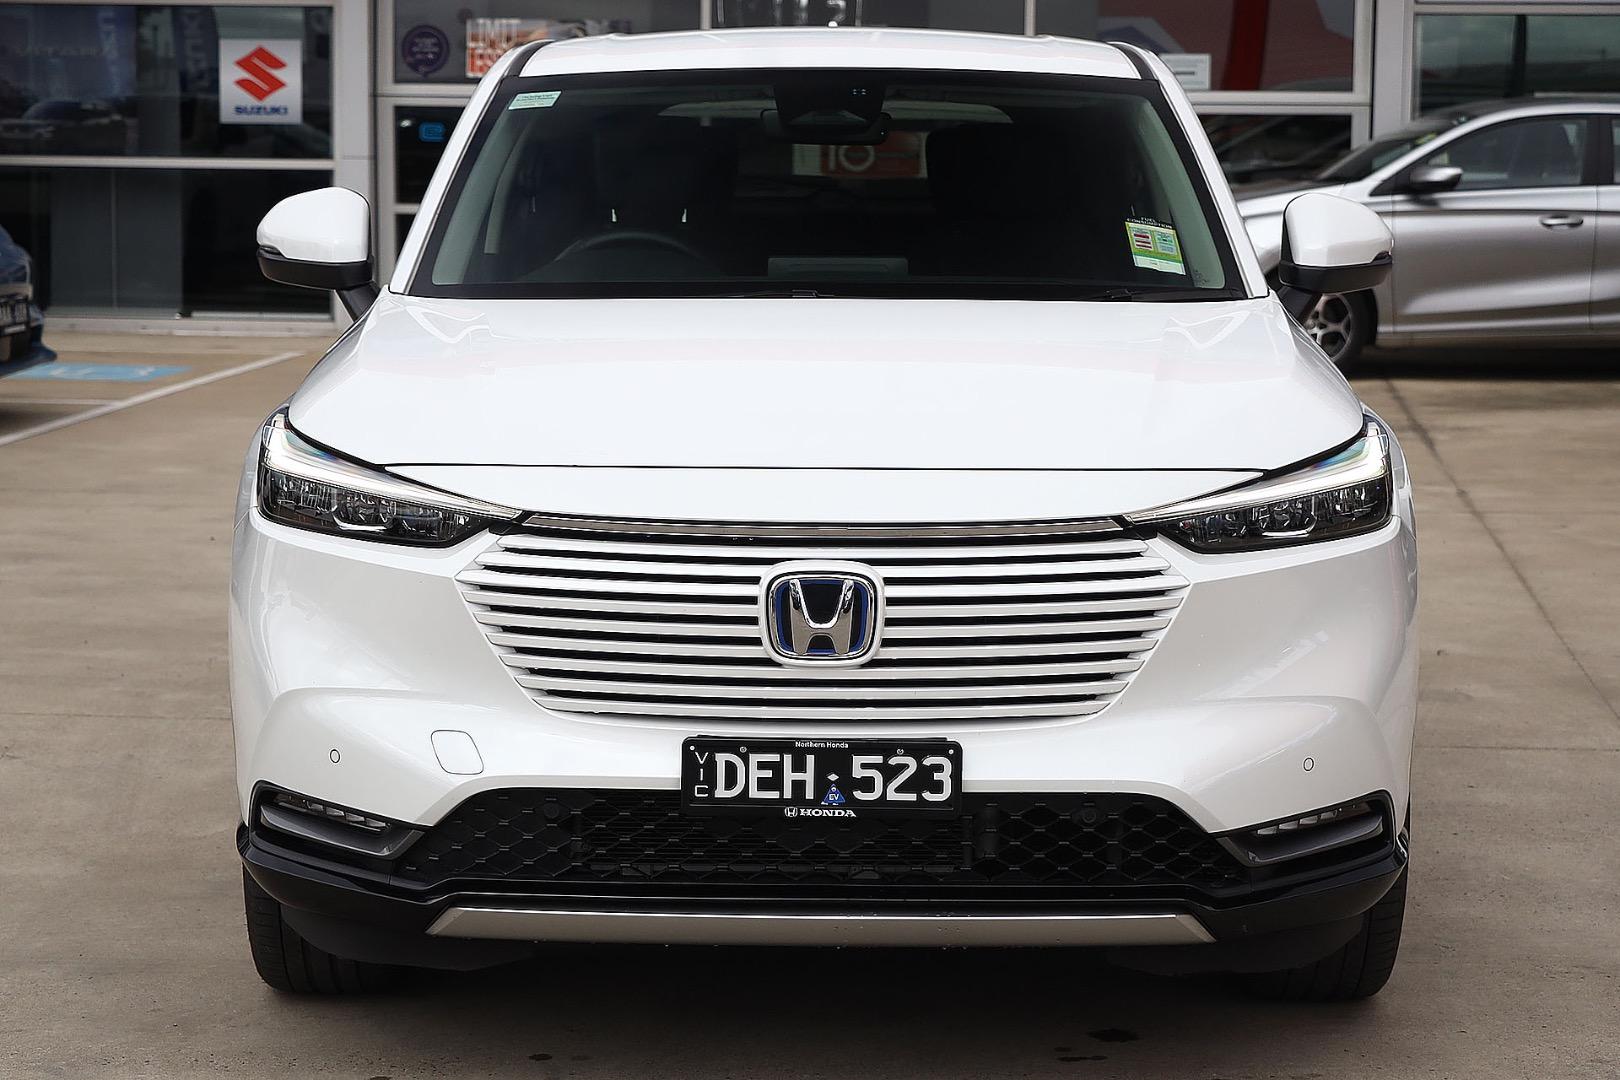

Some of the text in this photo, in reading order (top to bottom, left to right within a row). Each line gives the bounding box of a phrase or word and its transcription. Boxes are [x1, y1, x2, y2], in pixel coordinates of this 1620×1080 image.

[234, 105, 288, 116] SUZUKI
[826, 741, 849, 749] Honda
[695, 751, 709, 797] VIC
[714, 753, 952, 802] DEH 523
[828, 793, 839, 801] EV
[799, 808, 857, 818] HONDA
